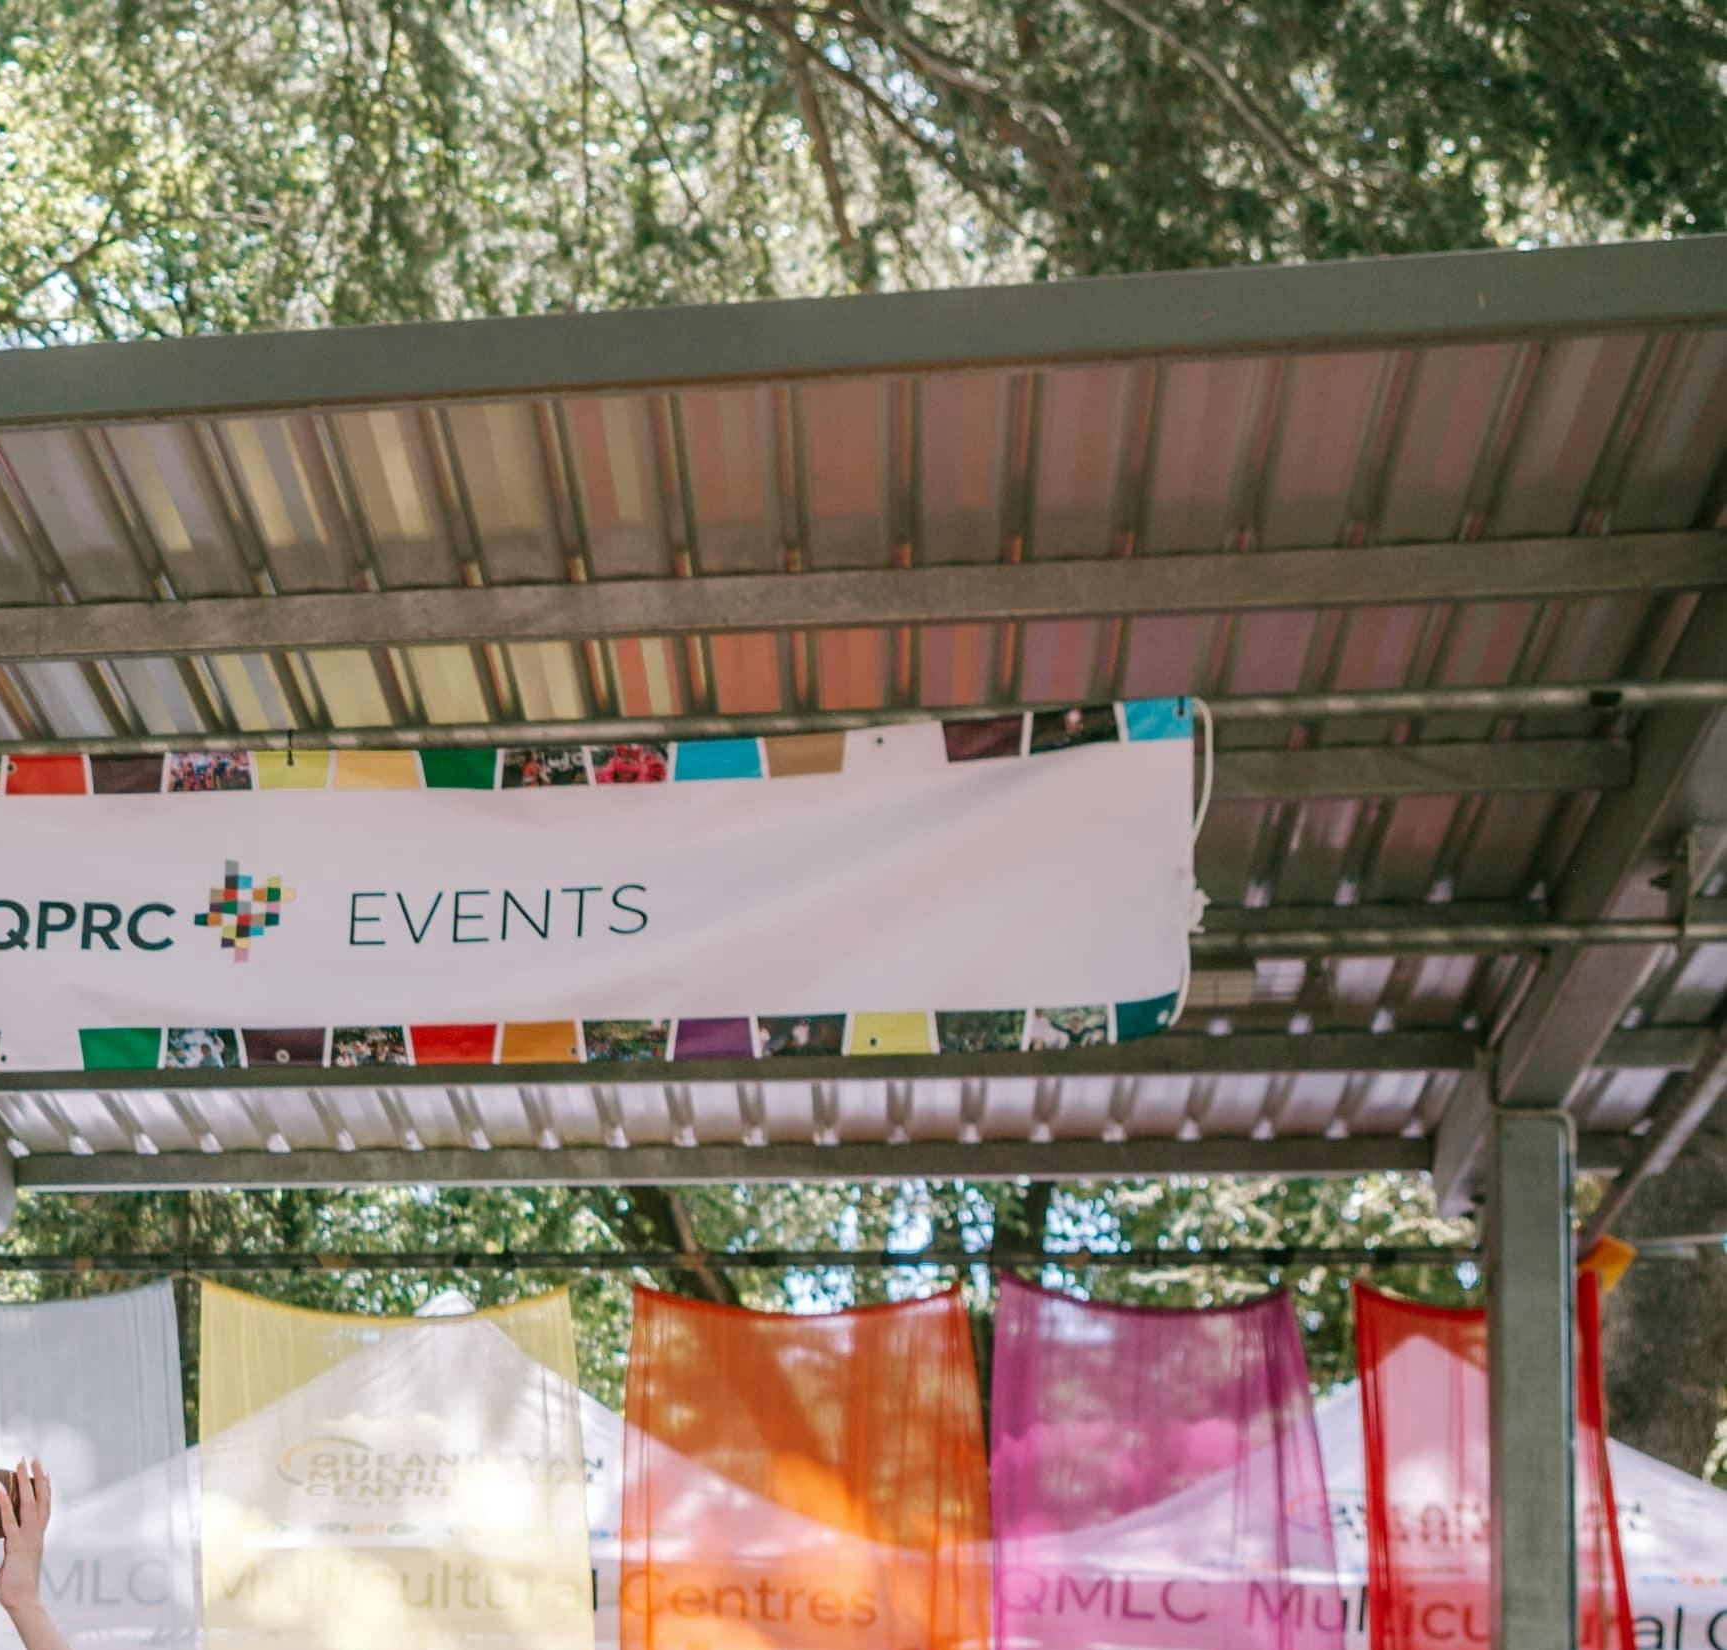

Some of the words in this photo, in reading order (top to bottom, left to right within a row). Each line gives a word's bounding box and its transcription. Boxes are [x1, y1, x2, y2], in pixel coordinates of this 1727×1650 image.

[347, 884, 649, 946] EVENTS
[309, 1452, 604, 1472] QUEANYAN
[207, 1558, 598, 1611] Mltultural
[620, 1567, 879, 1629] Centres
[995, 1569, 1209, 1624] QMLC
